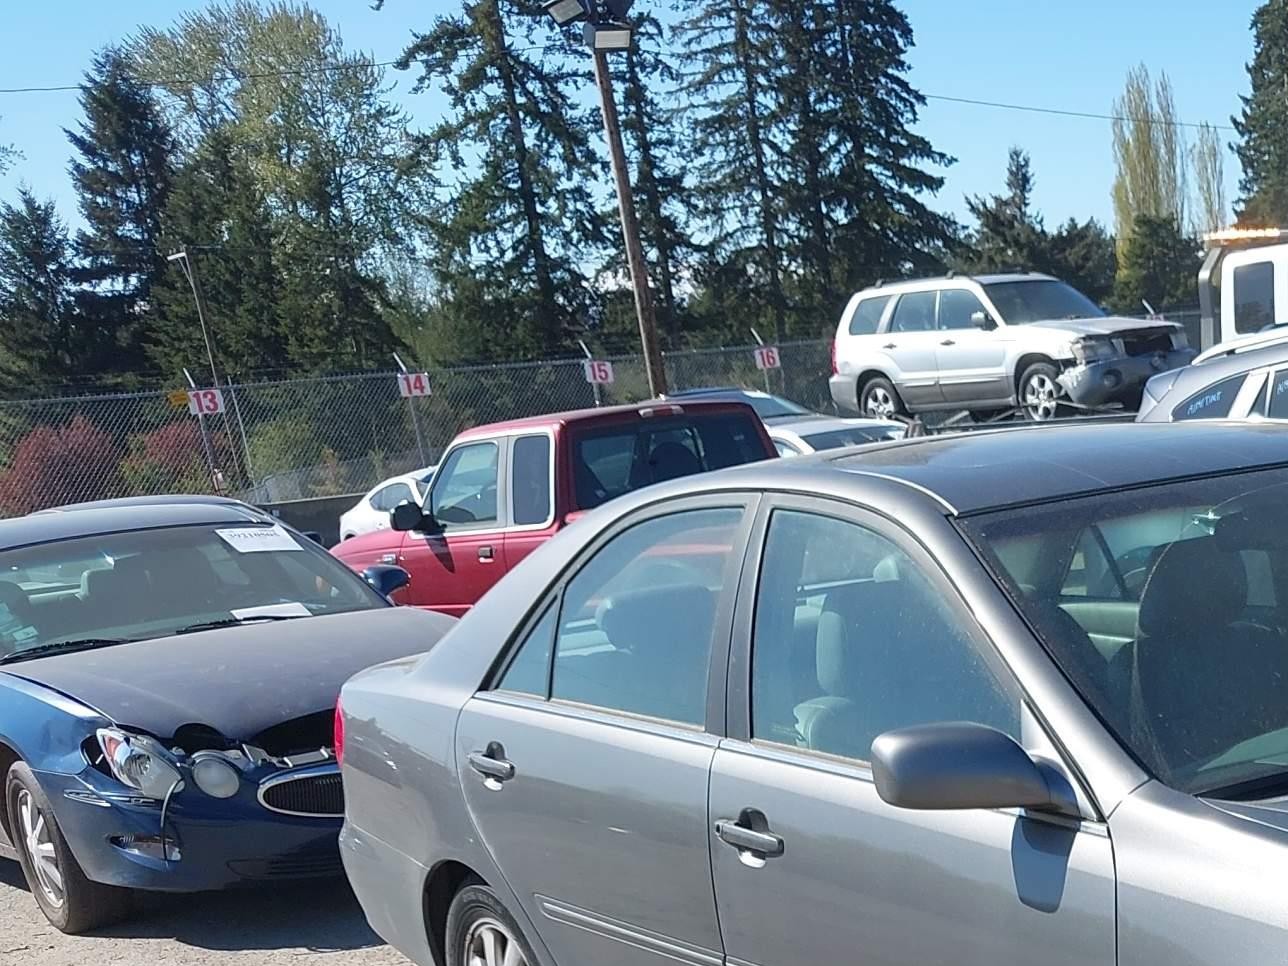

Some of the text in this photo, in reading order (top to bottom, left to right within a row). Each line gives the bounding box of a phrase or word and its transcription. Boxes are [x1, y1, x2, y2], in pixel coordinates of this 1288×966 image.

[760, 349, 776, 367] 16
[591, 362, 609, 381] 15
[403, 375, 425, 395] 14
[192, 391, 219, 412] 13
